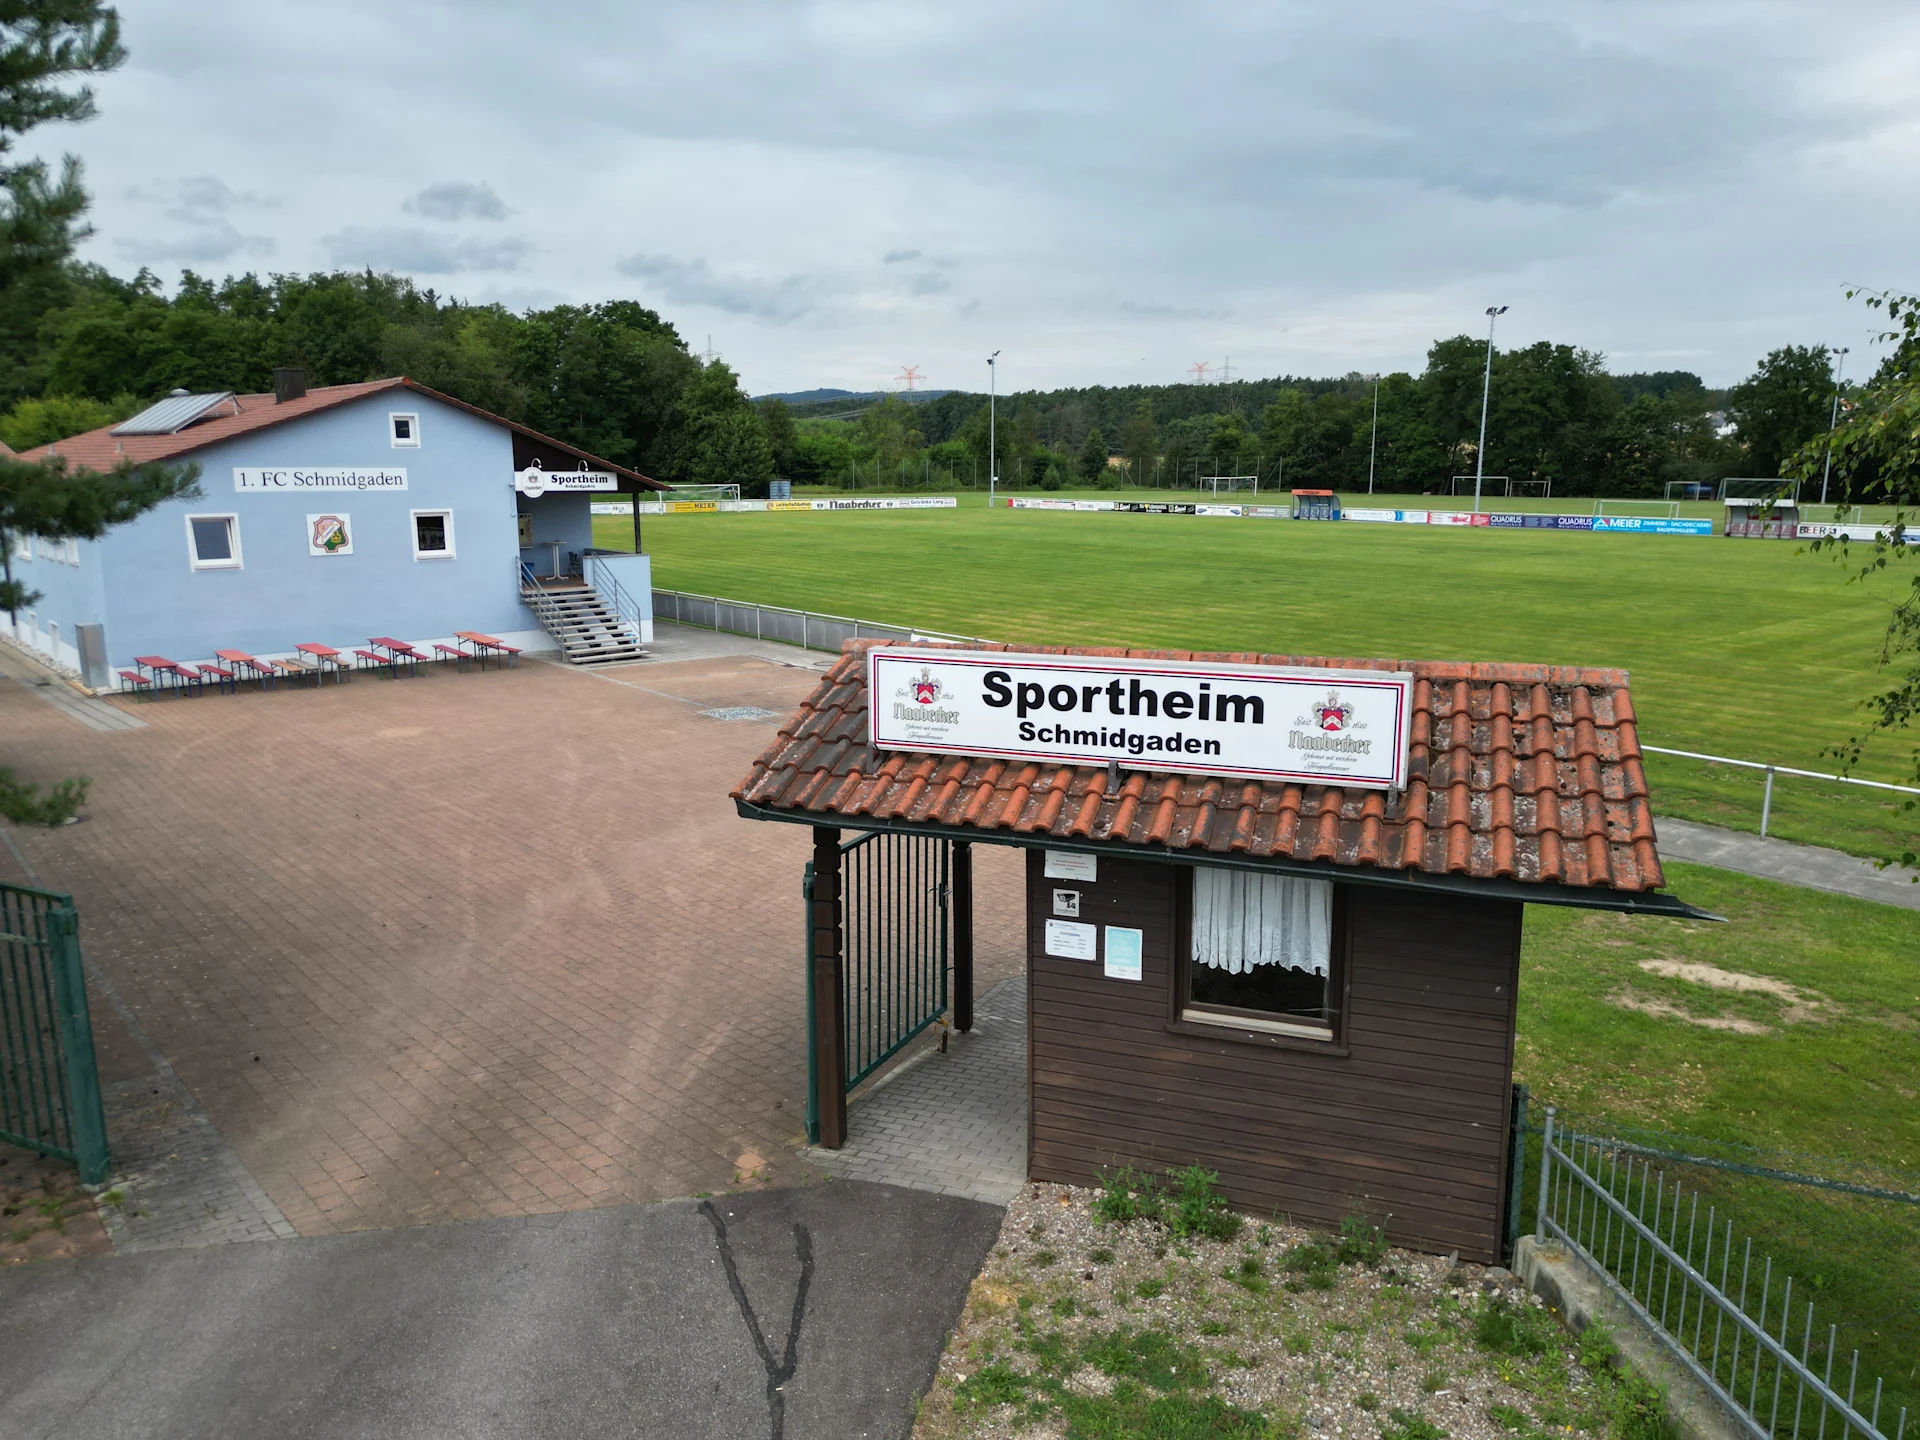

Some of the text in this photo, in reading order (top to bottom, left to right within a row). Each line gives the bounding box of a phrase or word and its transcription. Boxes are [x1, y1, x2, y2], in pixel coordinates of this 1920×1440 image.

[240, 471, 404, 490] 1. FC Schmidgaden
[551, 474, 609, 485] Sportheim
[1490, 515, 1522, 524] QUADRUS
[1558, 517, 1592, 526] QUADRUS
[1609, 519, 1641, 528] MEIER
[1799, 526, 1827, 534] BEER
[895, 687, 910, 698] Seit
[982, 670, 1265, 724] Sportheim
[892, 702, 961, 725] Naabecker
[1294, 715, 1368, 730] Seit 1620
[1018, 721, 1221, 756] Schmidgaden
[1288, 729, 1373, 756] Naabecker
